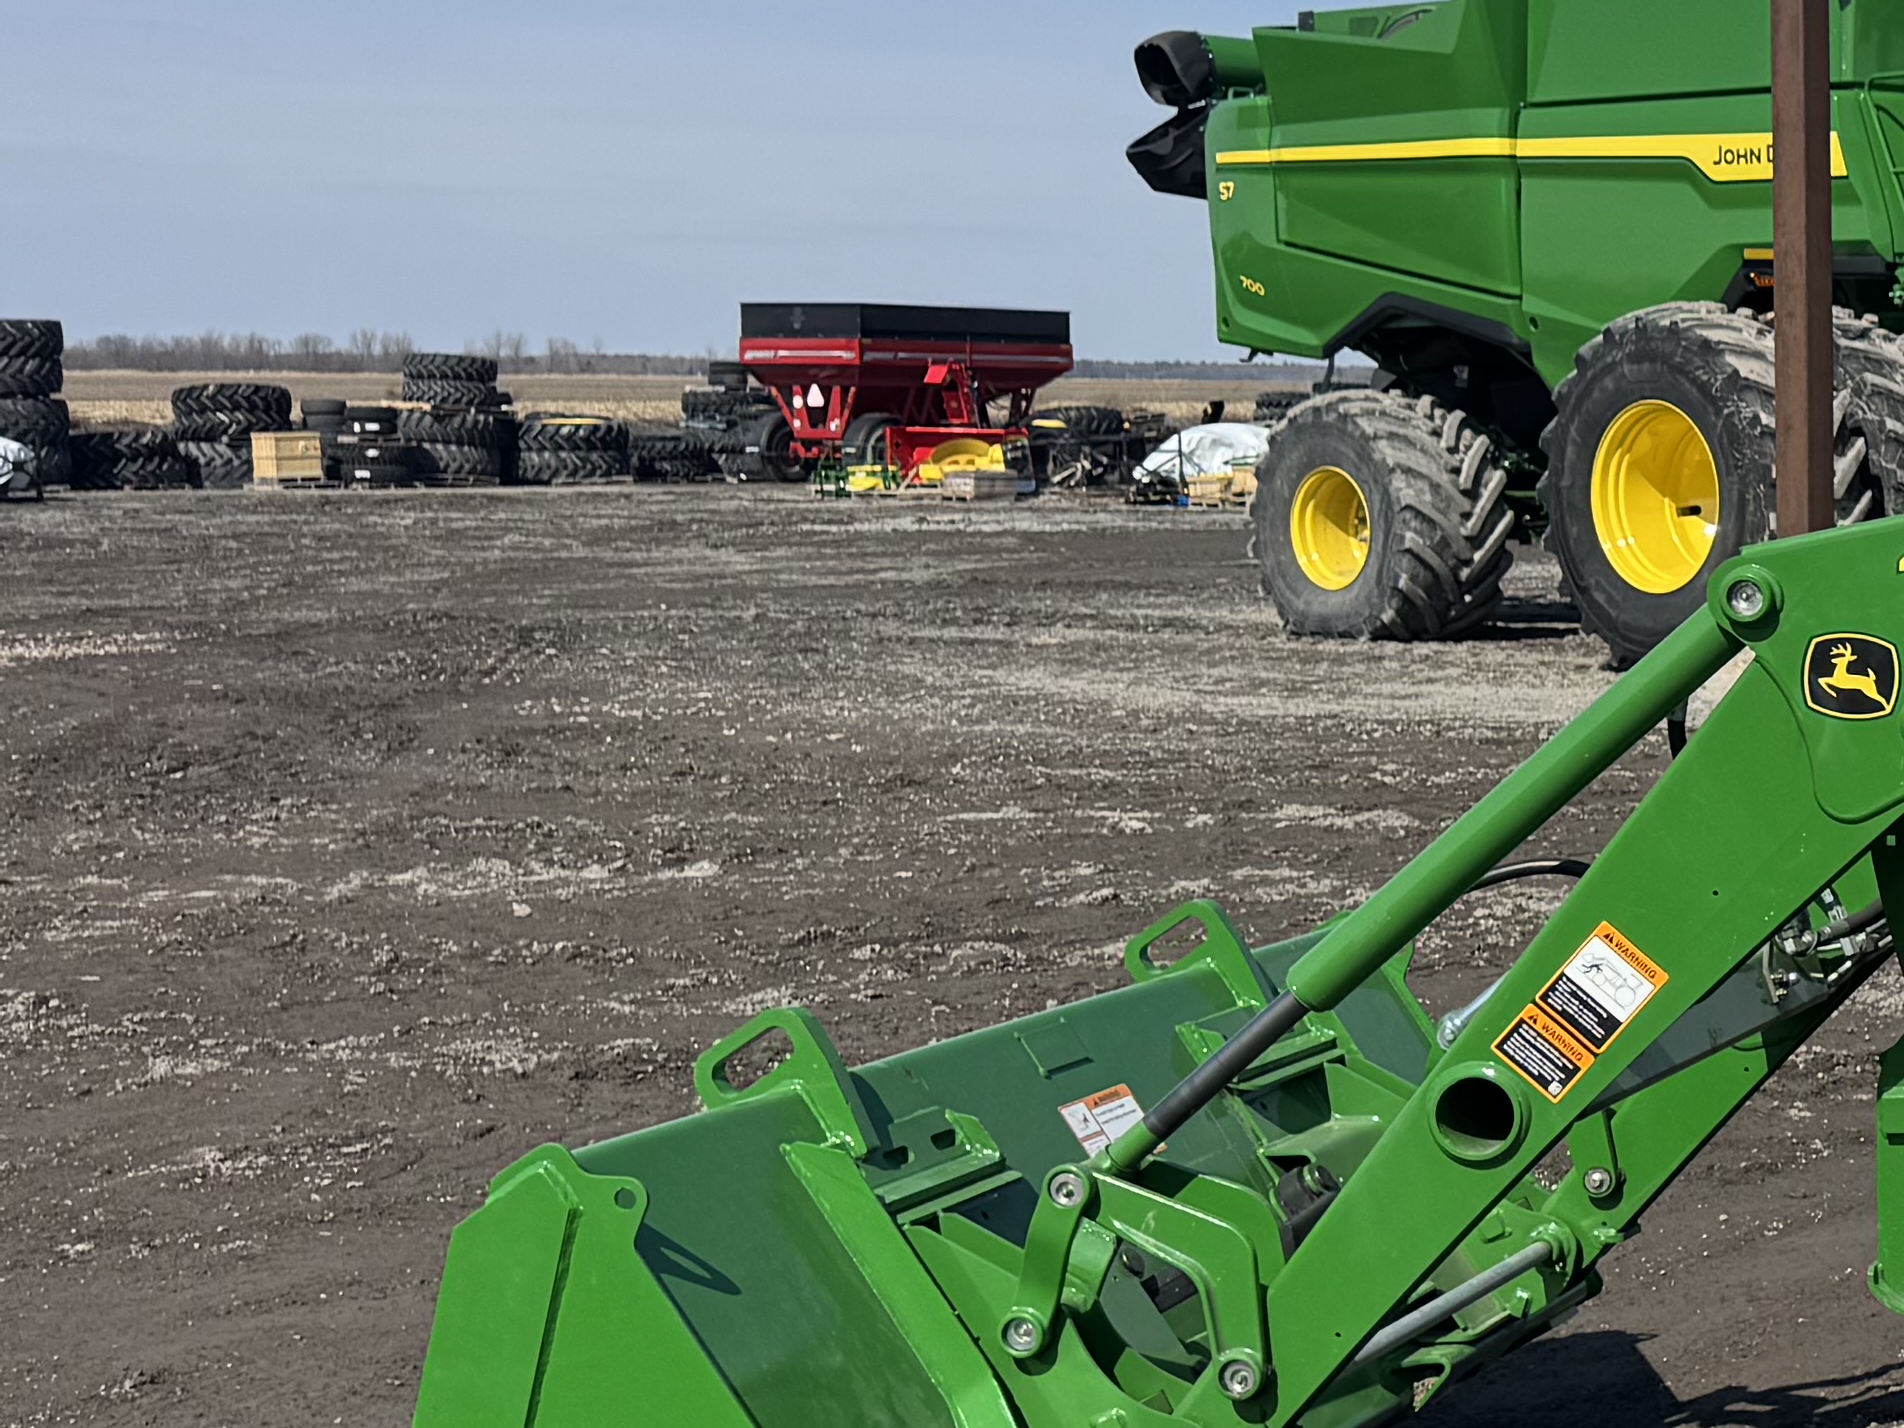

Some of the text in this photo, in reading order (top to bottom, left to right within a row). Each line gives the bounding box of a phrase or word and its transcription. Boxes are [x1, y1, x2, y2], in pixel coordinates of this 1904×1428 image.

[1712, 144, 1762, 166] JOHN
[1218, 181, 1236, 201] S7
[1239, 274, 1266, 297] 700
[1612, 938, 1658, 980] WARNING
[1539, 1020, 1585, 1062] WARNING
